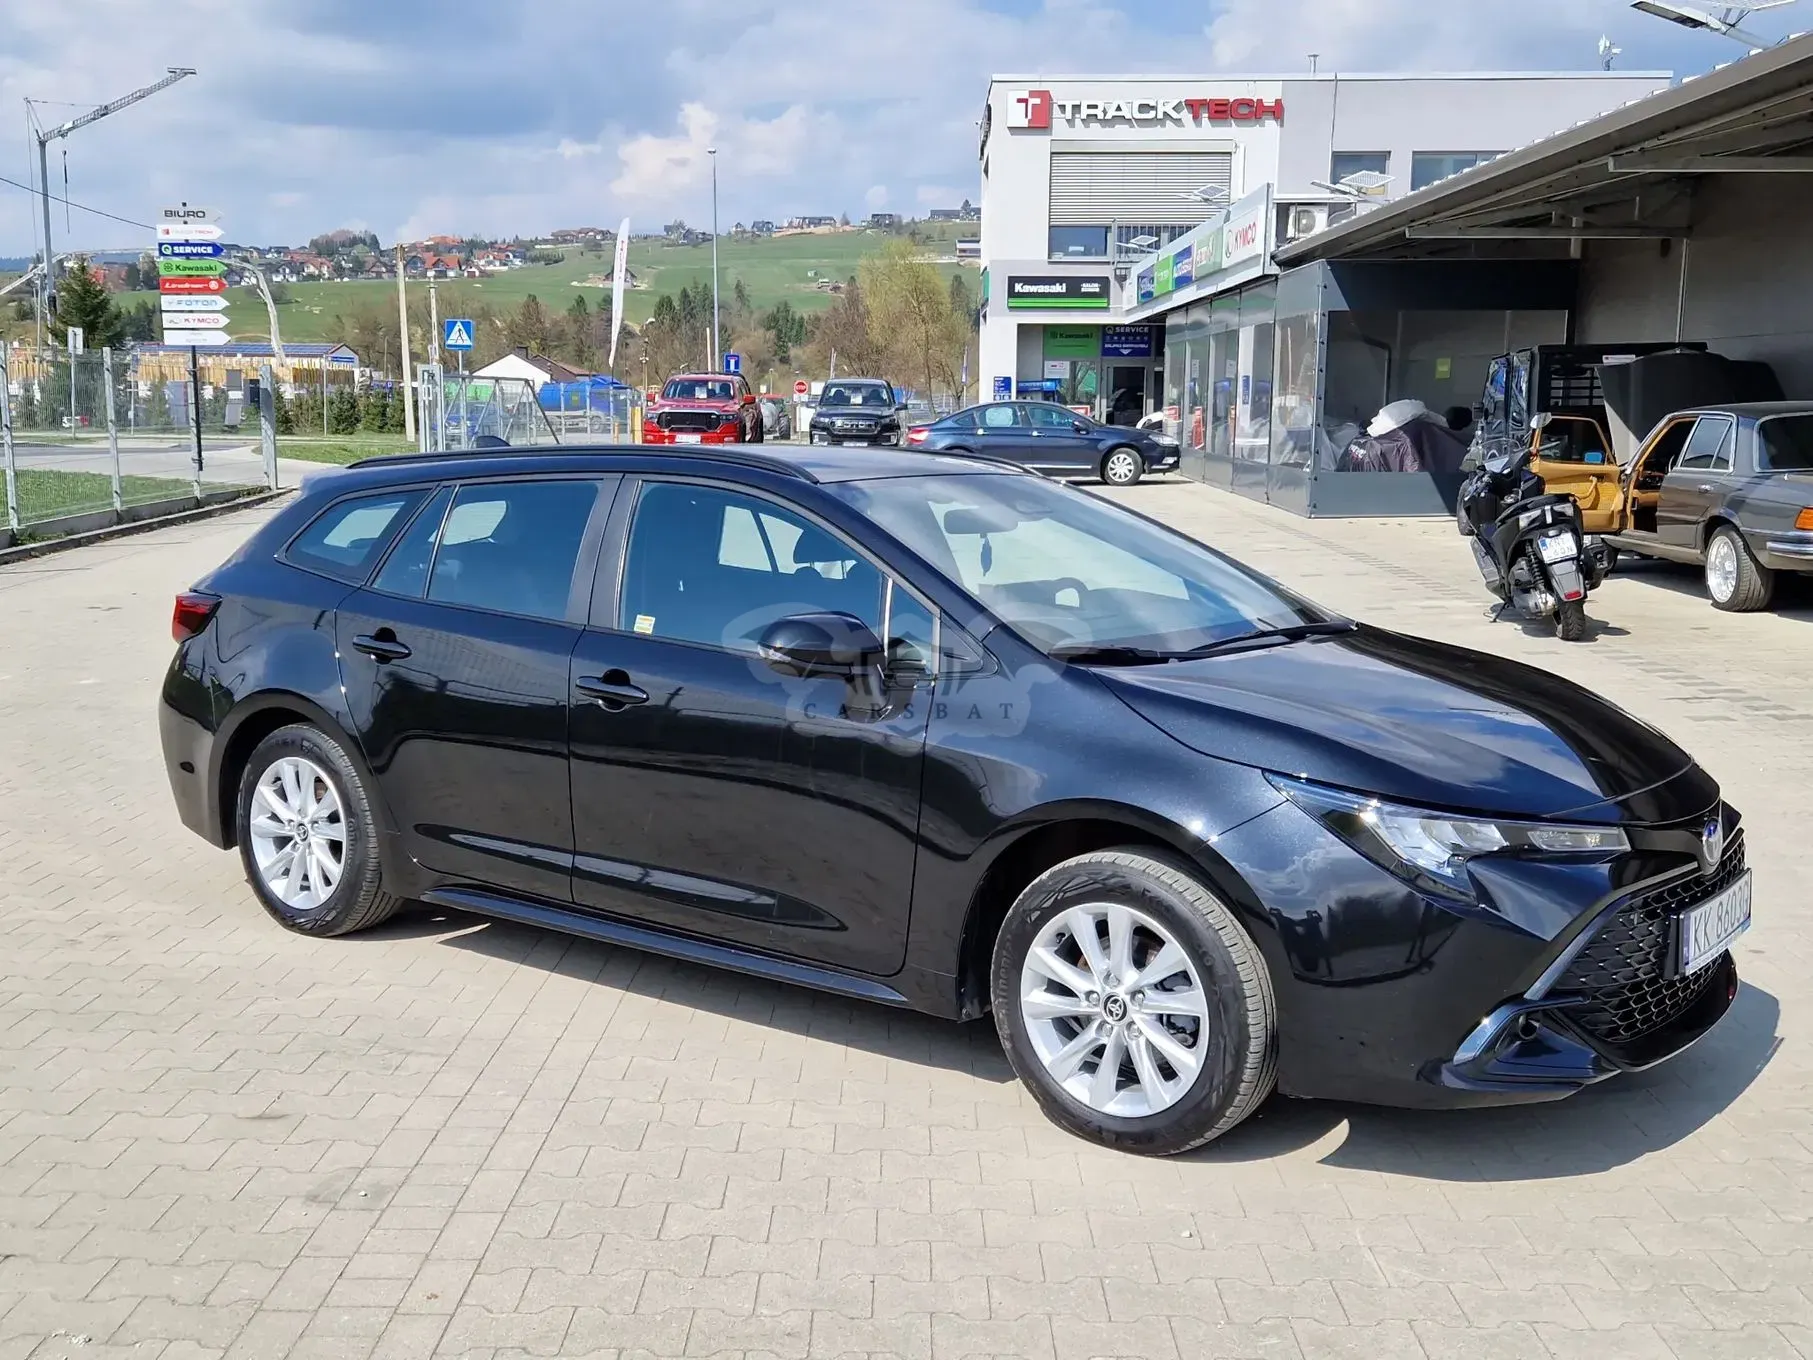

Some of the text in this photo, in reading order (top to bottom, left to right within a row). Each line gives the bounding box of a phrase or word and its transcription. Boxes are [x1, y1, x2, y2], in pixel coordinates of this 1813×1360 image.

[1057, 97, 1283, 120] TRACKTECH
[164, 209, 206, 219] BIURO
[1233, 221, 1257, 252] KYMCO
[173, 246, 214, 254] SERVICE
[174, 264, 218, 272] Kawasaki
[1014, 282, 1067, 294] Kawasaki
[1058, 331, 1093, 340] Kawasaki
[1693, 906, 1712, 957] KK
